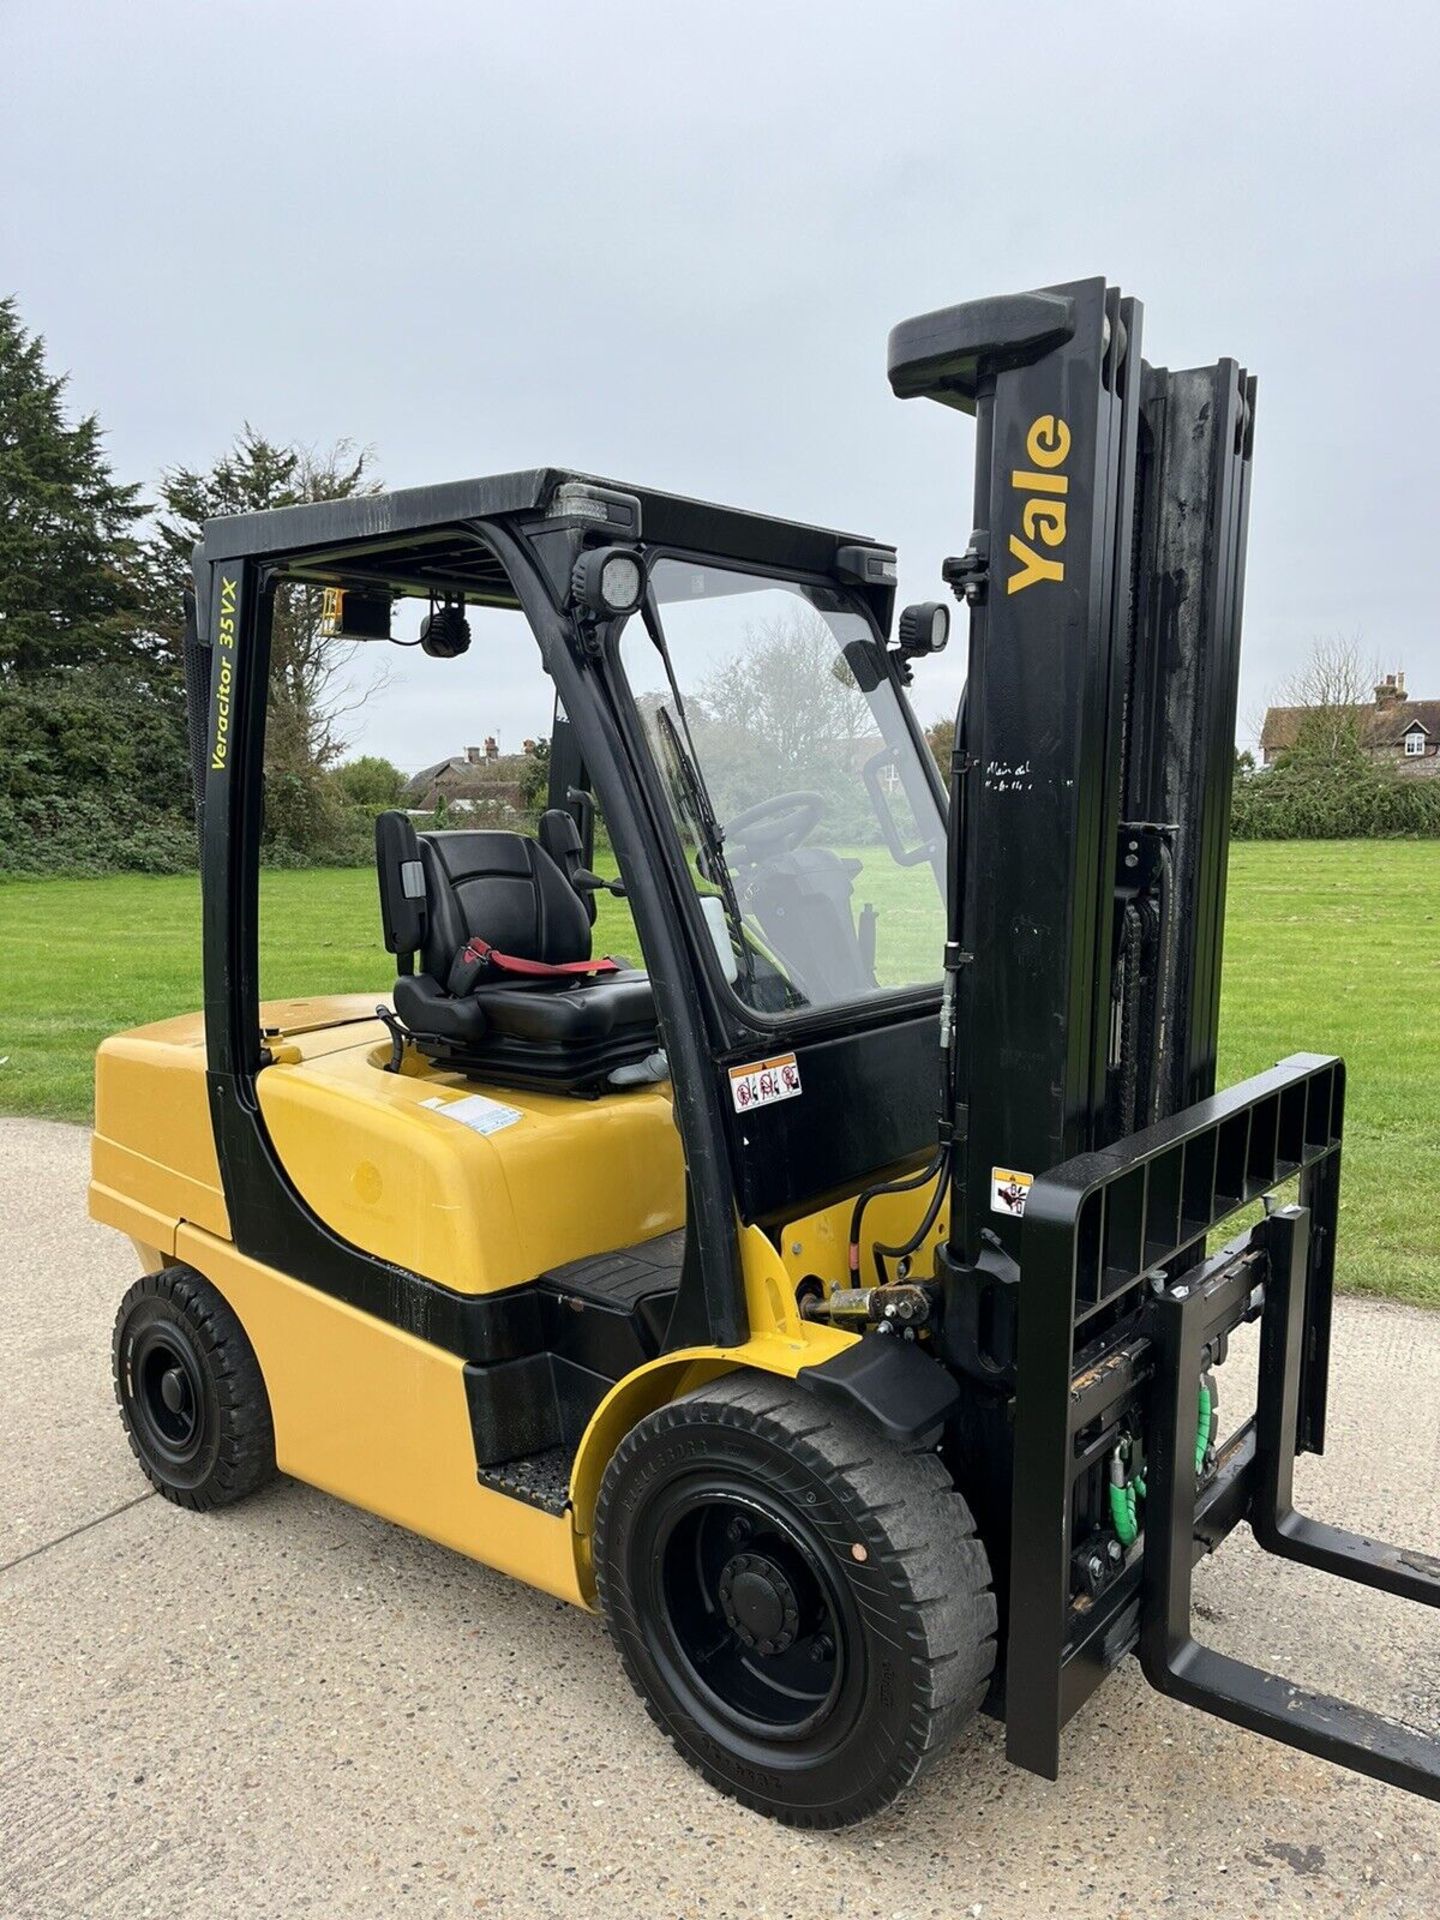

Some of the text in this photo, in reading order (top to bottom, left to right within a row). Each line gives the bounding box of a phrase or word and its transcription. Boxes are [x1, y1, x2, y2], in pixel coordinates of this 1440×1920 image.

[1008, 415, 1071, 595] Yale
[211, 577, 237, 770] Veracitor 35VX
